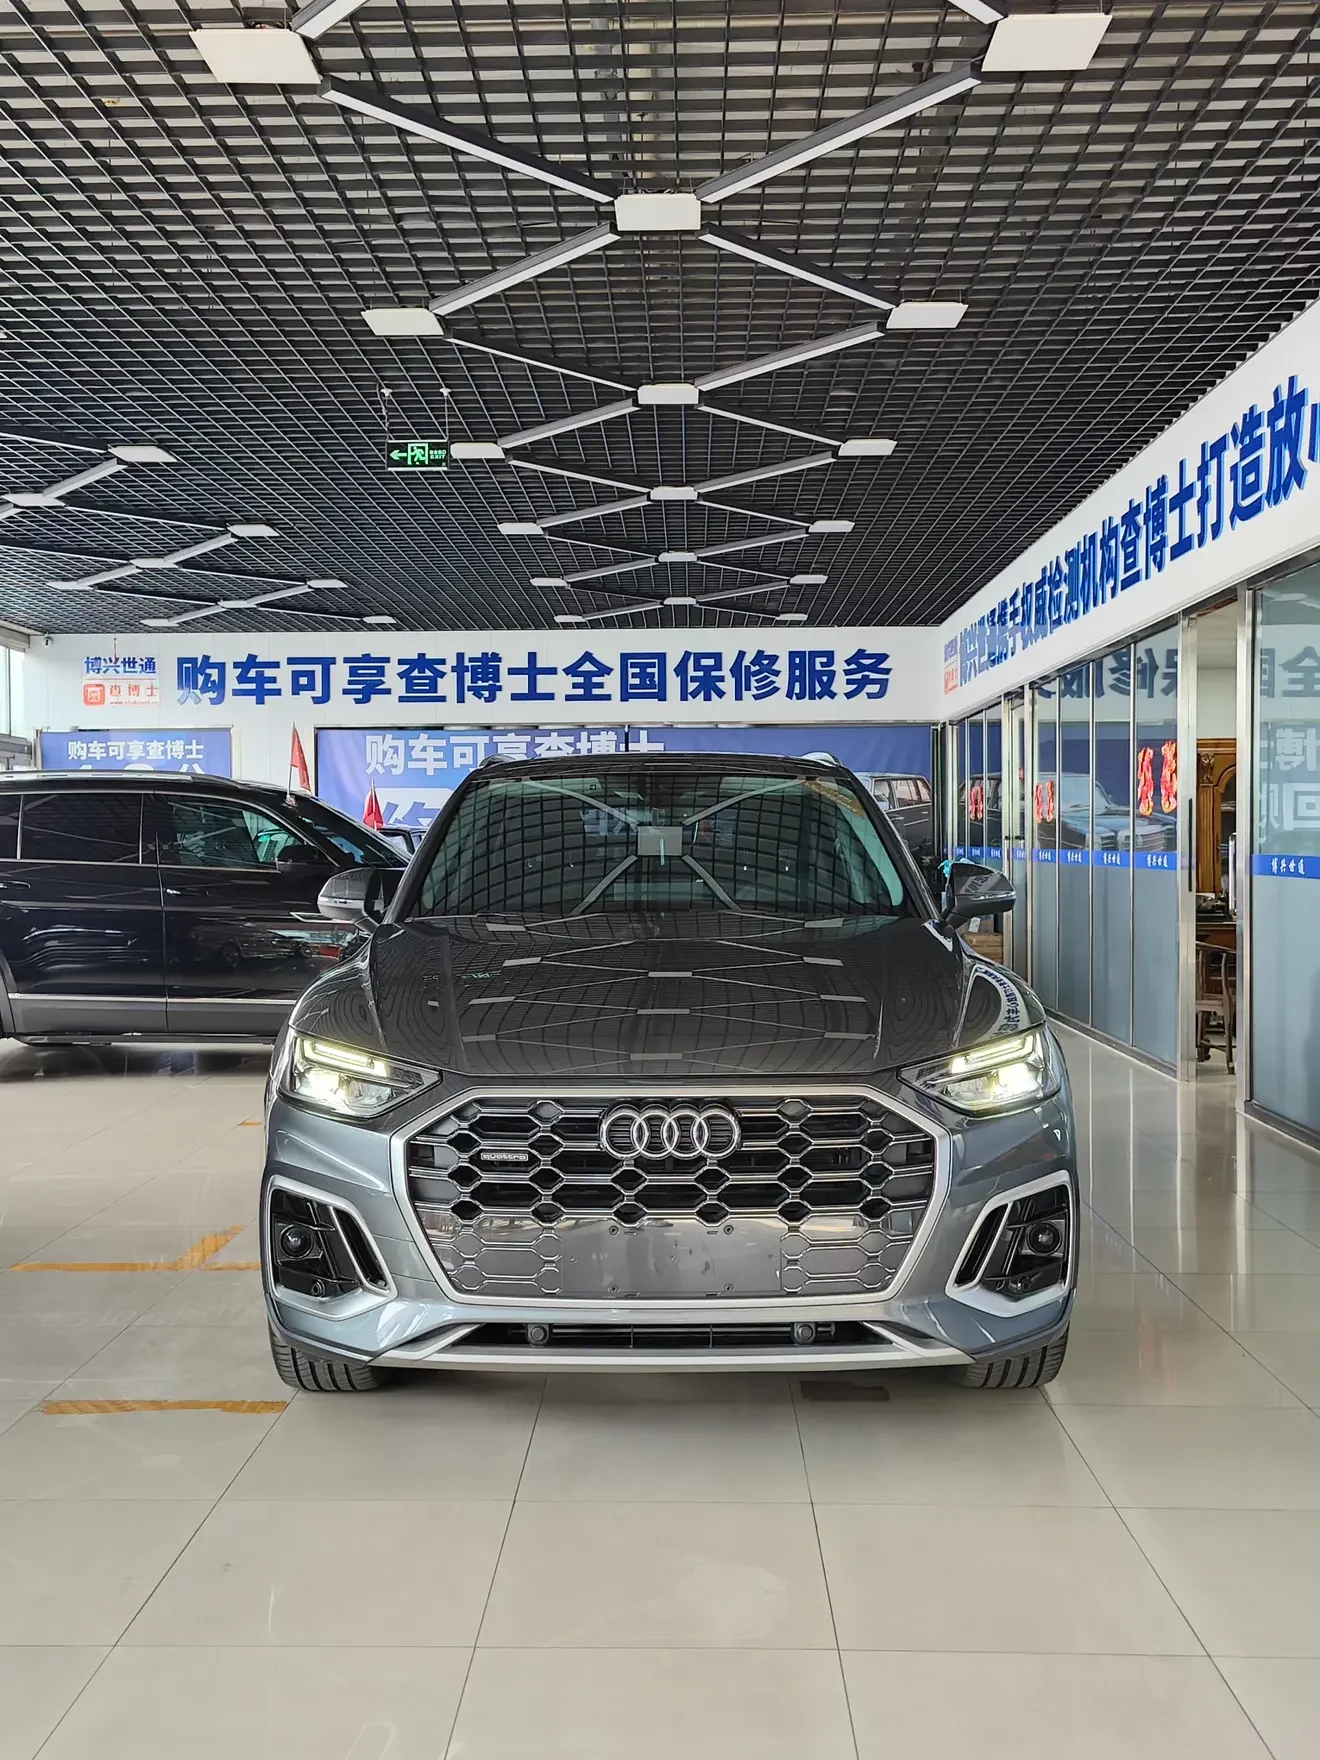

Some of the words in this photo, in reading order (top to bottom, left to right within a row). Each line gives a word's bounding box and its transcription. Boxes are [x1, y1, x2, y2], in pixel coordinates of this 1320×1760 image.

[84, 656, 157, 675] 博兴世通
[176, 648, 893, 706] 购车可享查博士全国保修服务
[67, 739, 204, 761] 购车可享查博士
[482, 1153, 527, 1161] quattro
